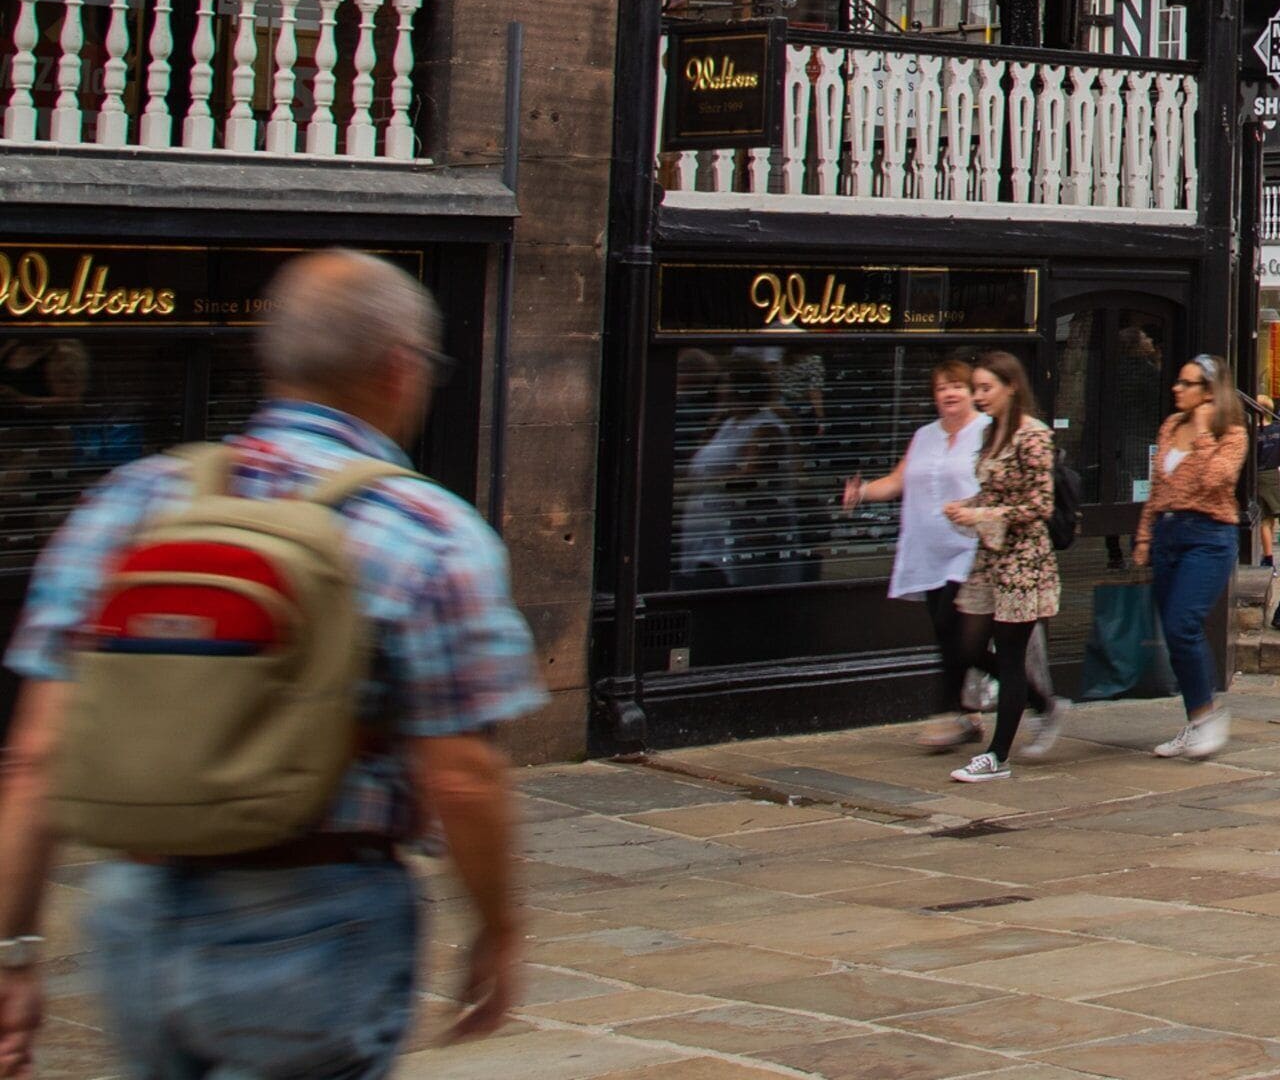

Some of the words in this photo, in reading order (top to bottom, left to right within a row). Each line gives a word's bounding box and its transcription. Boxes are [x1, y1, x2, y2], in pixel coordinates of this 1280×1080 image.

[686, 56, 758, 91] Waltons
[0, 251, 177, 315] Waltons
[194, 298, 238, 314] Since
[751, 273, 892, 324] Waltons
[904, 311, 935, 323] Since
